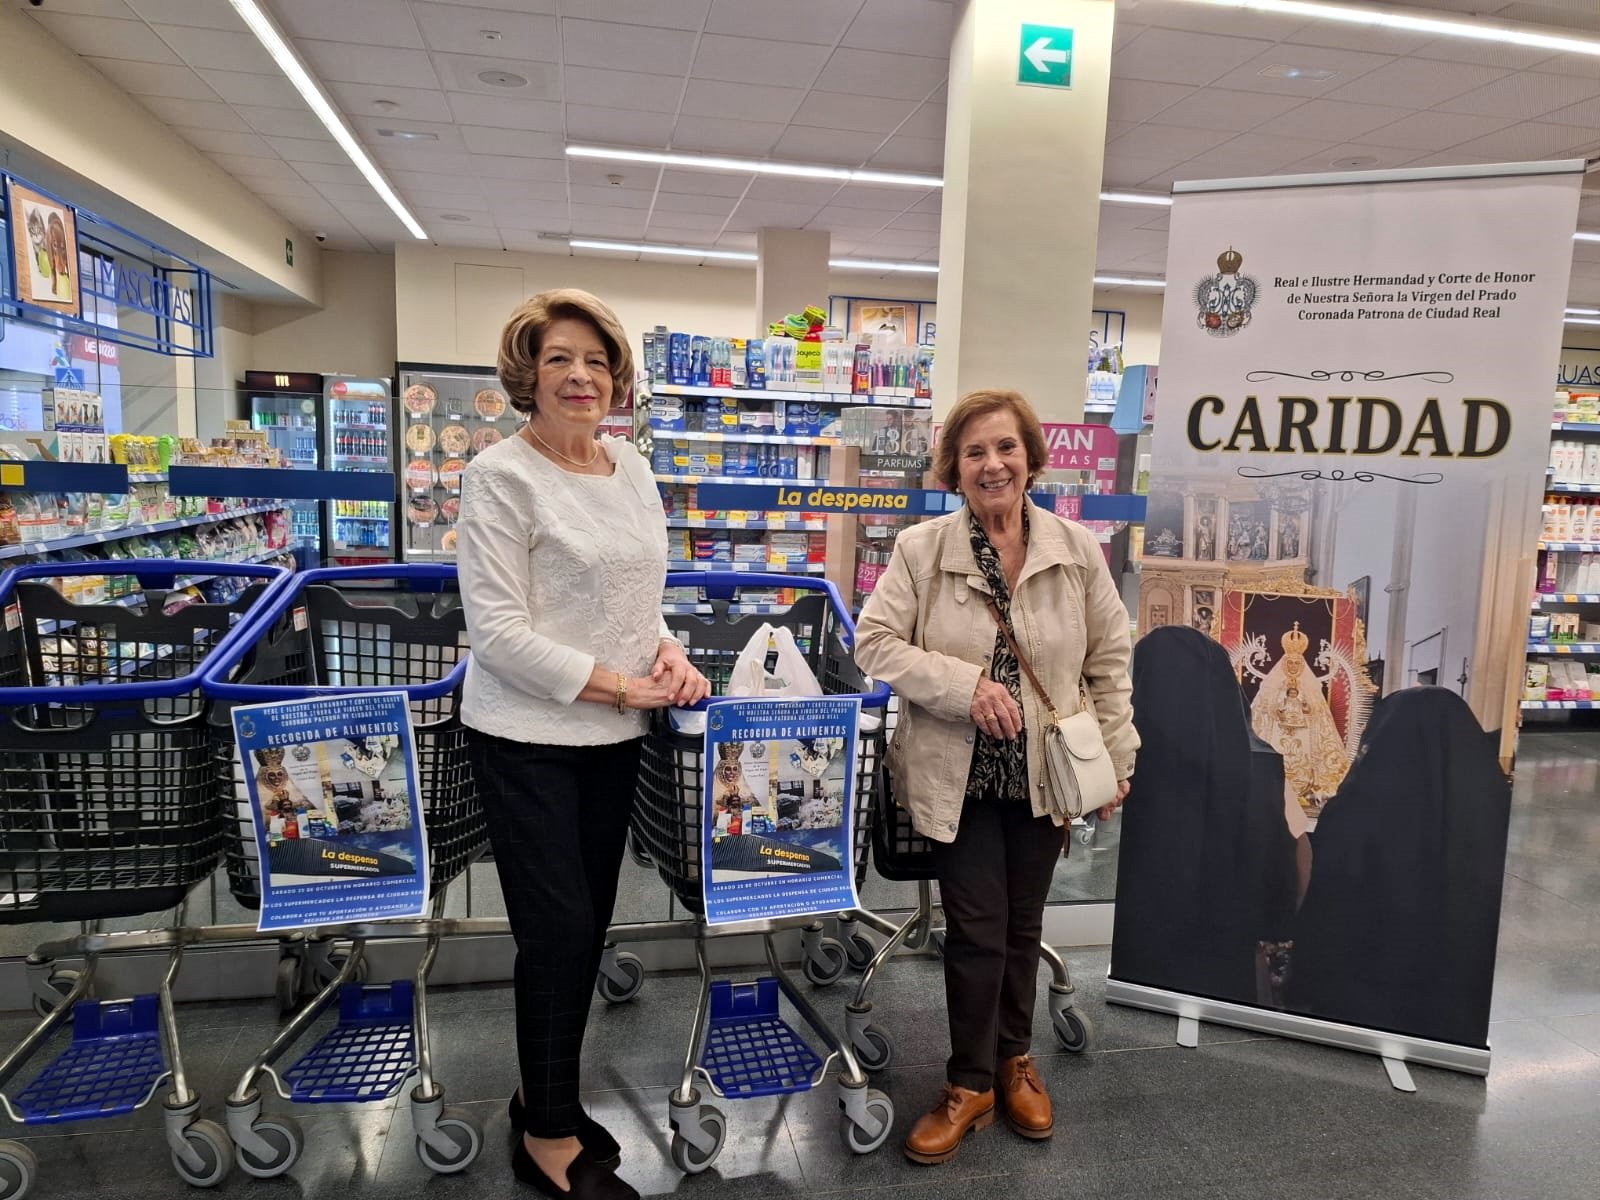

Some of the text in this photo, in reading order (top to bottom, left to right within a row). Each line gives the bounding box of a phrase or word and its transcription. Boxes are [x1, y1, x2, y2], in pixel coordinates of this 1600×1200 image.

[1274, 271, 1536, 288] Real e Ilustre Hermandad y Corte de Honor
[101, 256, 190, 323] MASCOTAS
[1287, 289, 1516, 305] de Nuestra Señora la Virgen del Prado
[1298, 306, 1500, 321] Coronada Patrona de Ciudad Real
[1187, 395, 1512, 459] CARIDAD
[877, 458, 922, 469] PARFUMS
[777, 487, 908, 511] La despensa
[268, 722, 399, 745] RECOGIDA DE ALIMENTOS
[732, 726, 847, 738] RECOGIDA DE ALIMENTOS
[322, 849, 378, 866] La despensa
[760, 846, 809, 861] La despensa
